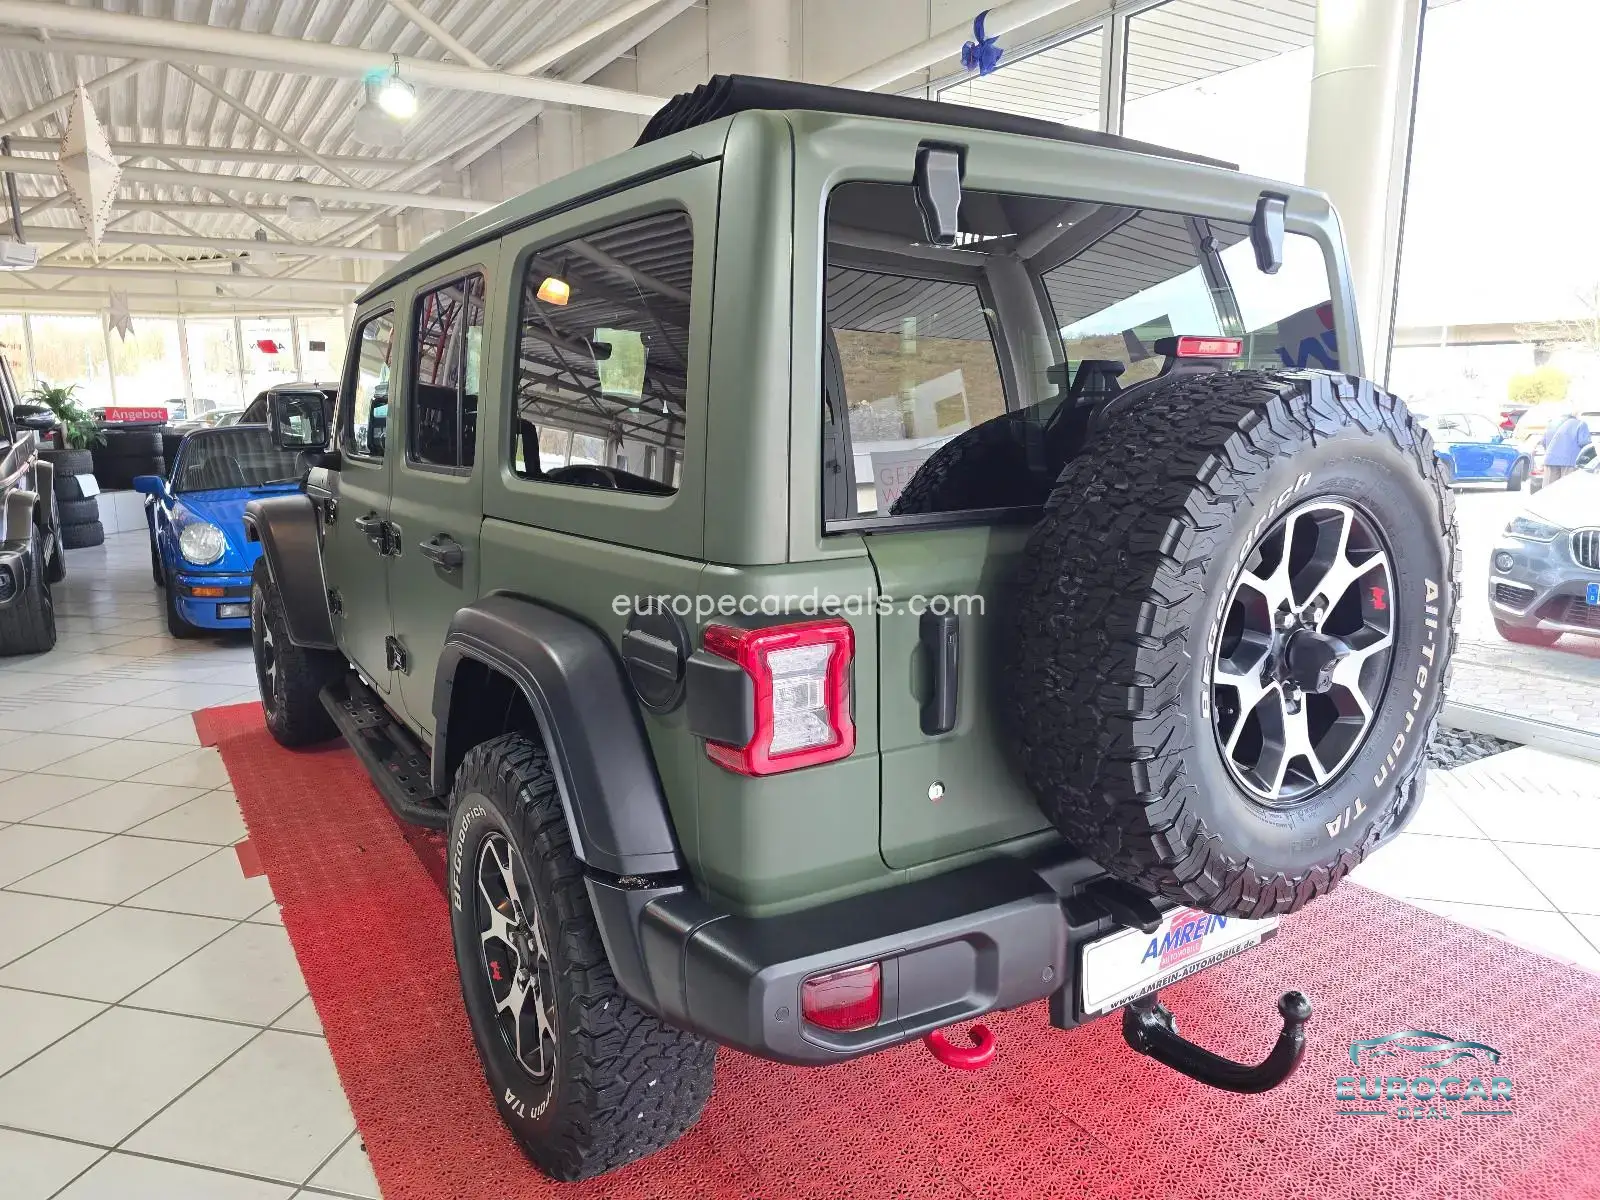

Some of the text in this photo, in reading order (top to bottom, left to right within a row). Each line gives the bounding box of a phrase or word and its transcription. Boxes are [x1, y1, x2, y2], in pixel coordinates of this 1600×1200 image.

[112, 409, 164, 421] Angebot
[1200, 471, 1312, 719] BFGoodrich
[1325, 577, 1439, 838] All-Terrain T/A
[454, 804, 487, 912] BFGoodrich
[1141, 913, 1228, 964] AMREIN
[1161, 942, 1200, 963] AUTOMOBILE
[1110, 939, 1255, 1009] www.AMREIN-AUTOMOBILE.de
